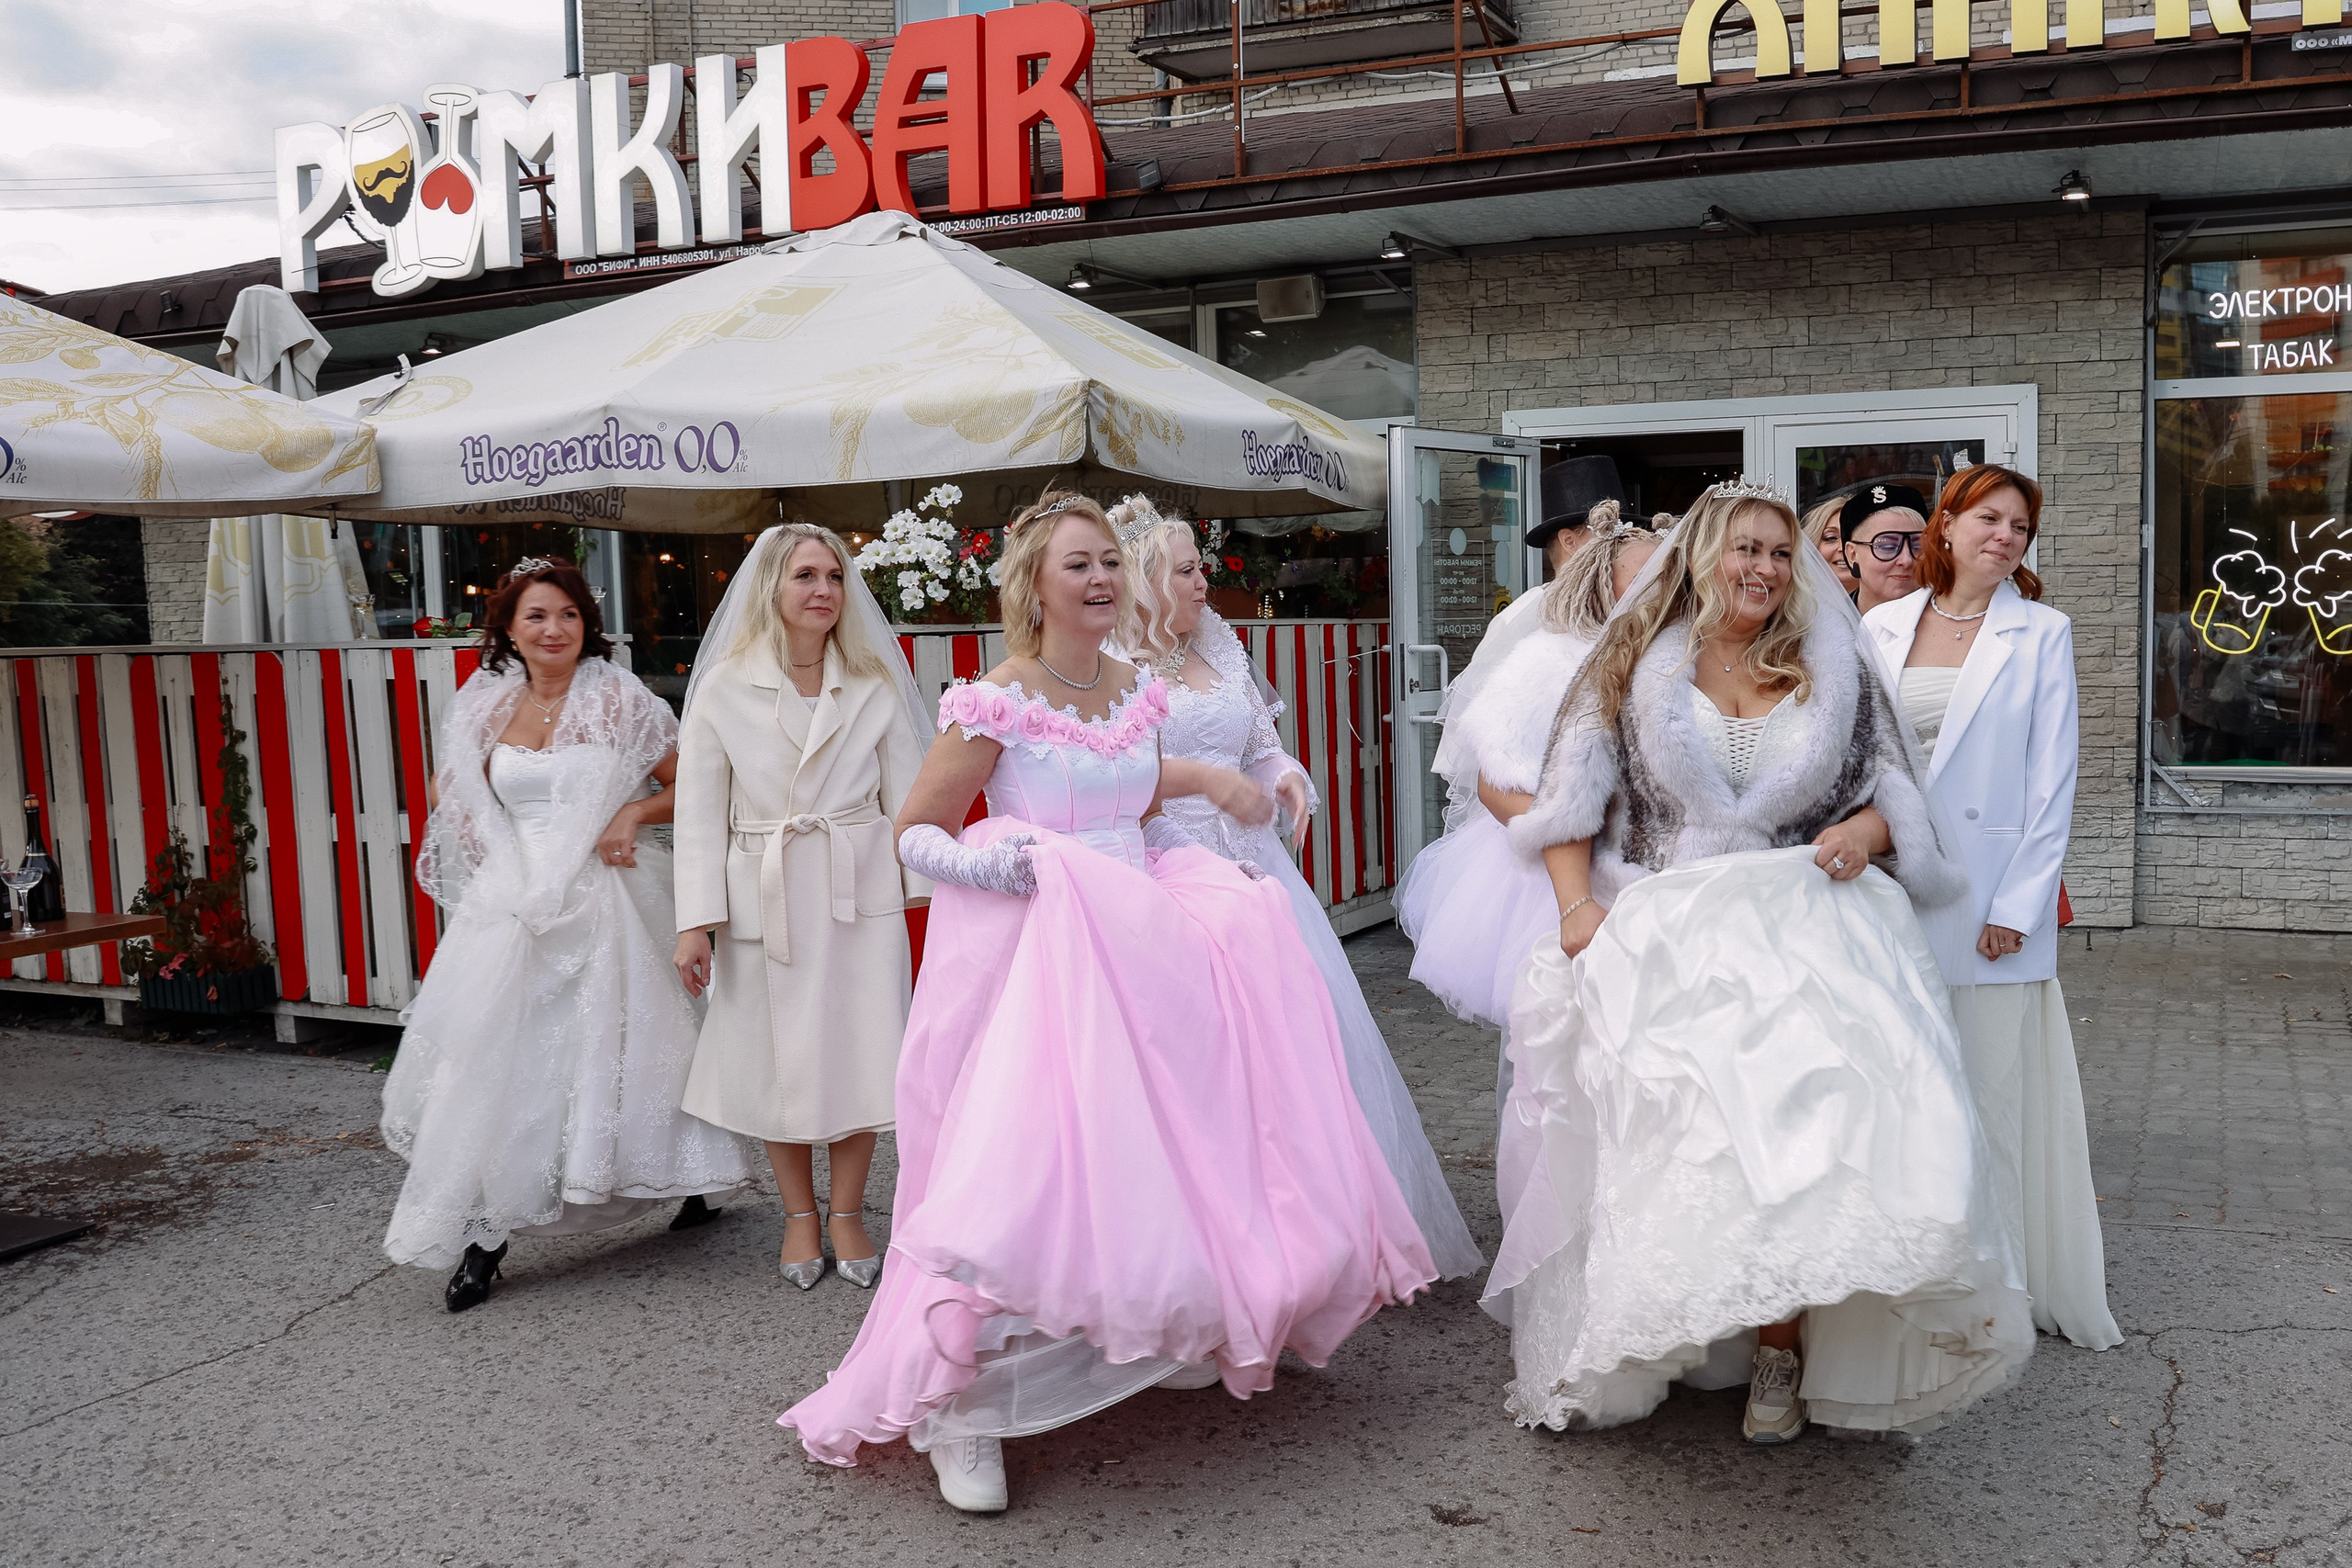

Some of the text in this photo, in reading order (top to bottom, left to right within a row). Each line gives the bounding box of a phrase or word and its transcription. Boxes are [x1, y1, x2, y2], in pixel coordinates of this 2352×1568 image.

[2295, 37, 2329, 50] ООО
[1019, 206, 1081, 224] 12:00-02:00
[575, 263, 597, 276] ООО
[639, 253, 661, 268] ИНН
[662, 249, 718, 266] 5406805301,
[718, 248, 734, 263] ул.
[2209, 284, 2352, 320] ЭЛЕКТРОН
[2246, 338, 2334, 370] ТАБАК
[673, 420, 741, 474] 0,0
[15, 457, 27, 471] %
[732, 461, 749, 473] Alc
[6, 472, 28, 484] Alc
[1872, 491, 1887, 504] S
